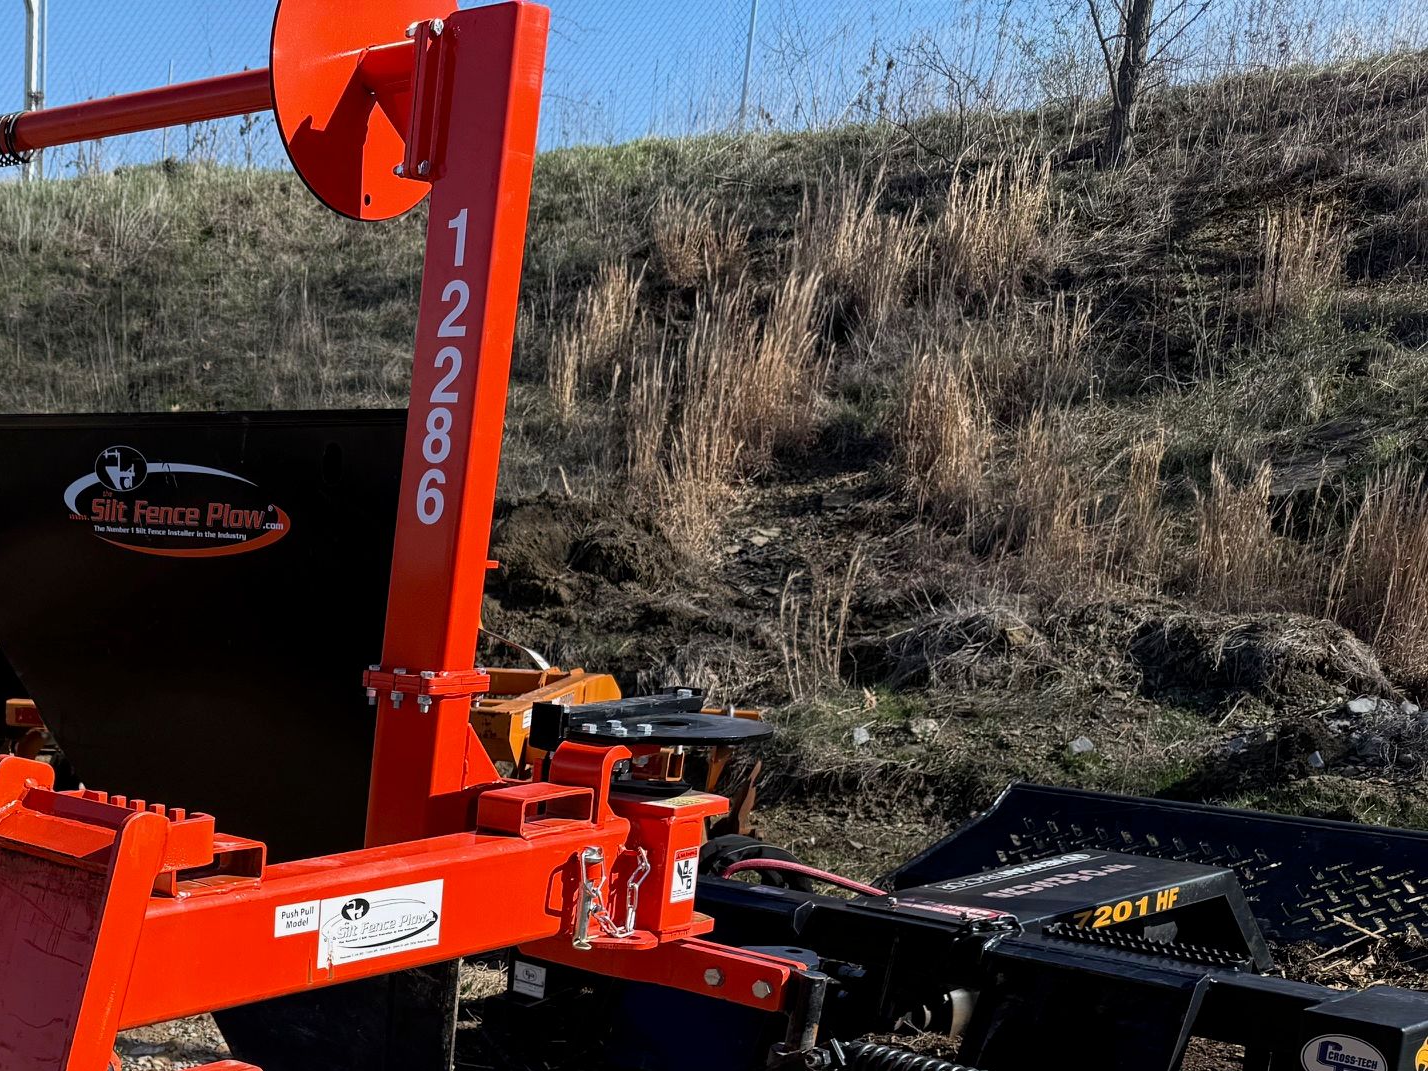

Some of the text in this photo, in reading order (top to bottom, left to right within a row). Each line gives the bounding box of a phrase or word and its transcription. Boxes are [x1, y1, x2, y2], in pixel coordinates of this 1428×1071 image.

[416, 208, 470, 525] 12286
[91, 498, 128, 524] Silt
[134, 500, 200, 527] Fence
[206, 502, 265, 530] Plow
[106, 525, 129, 534] Number
[135, 527, 147, 535] Silt
[148, 527, 166, 536] Fence
[168, 529, 195, 538] Installer
[218, 532, 247, 541] Industry
[281, 906, 315, 919] Push Pull
[1073, 886, 1180, 931] 7201 HF
[285, 917, 309, 929] Model
[1328, 1051, 1378, 1070] CROSS-TECH
